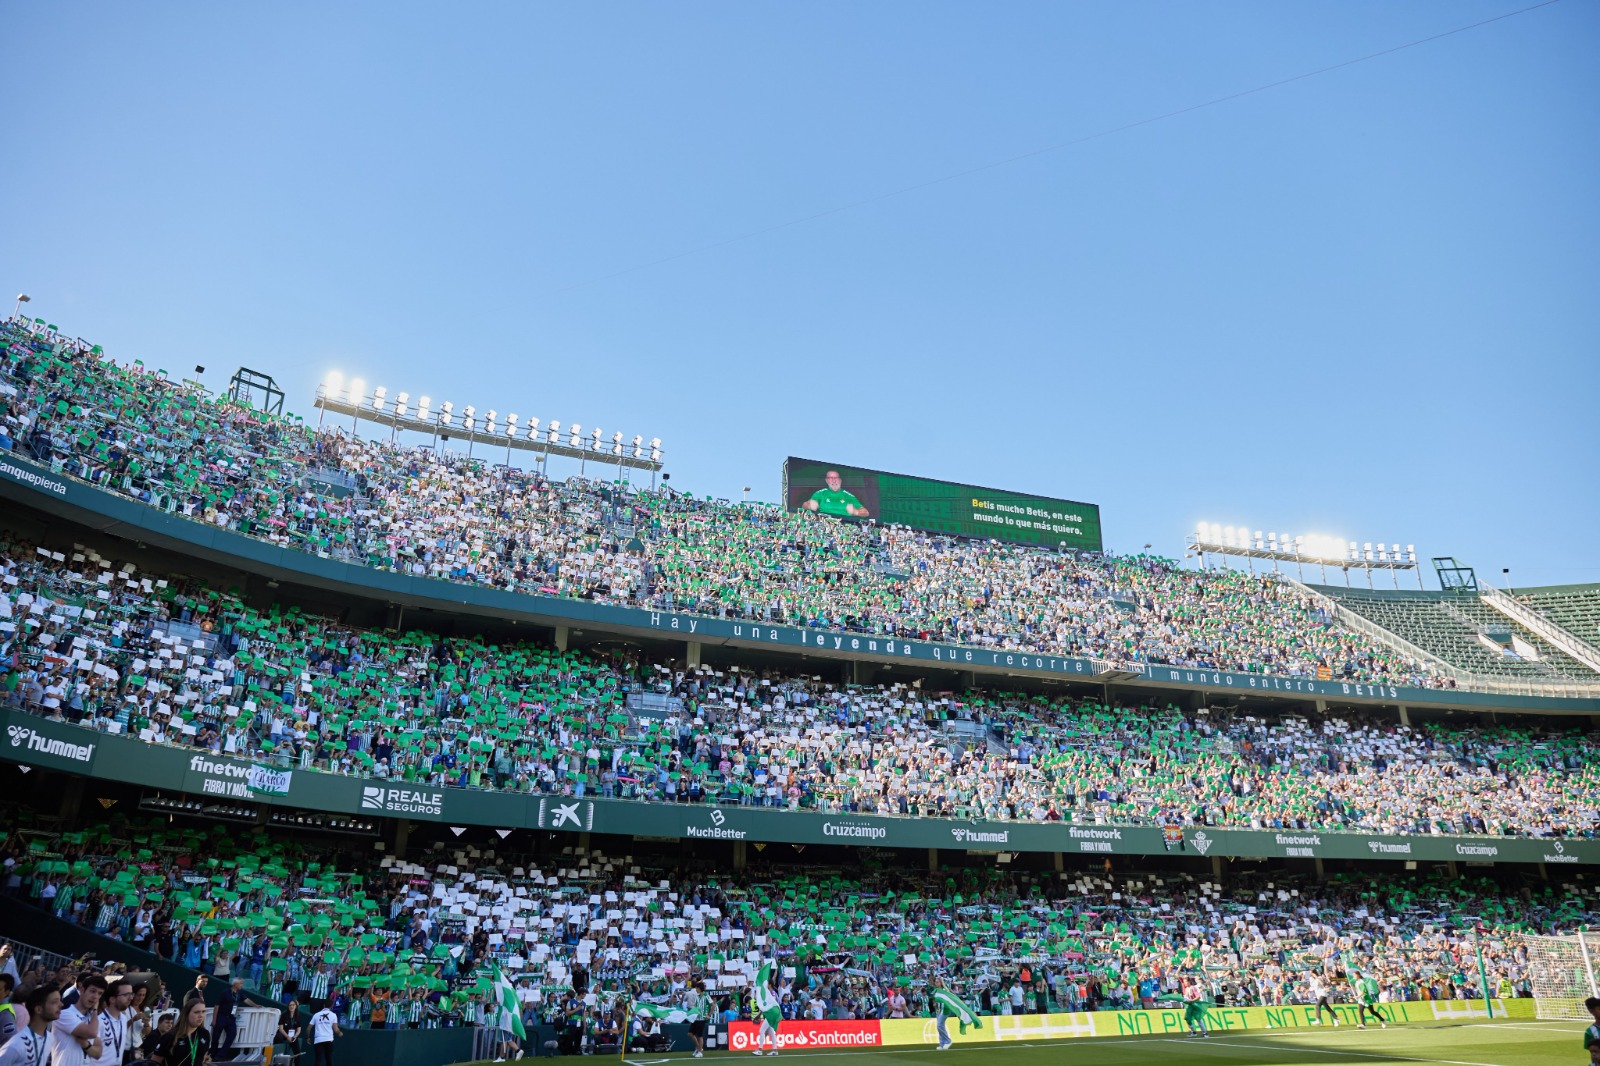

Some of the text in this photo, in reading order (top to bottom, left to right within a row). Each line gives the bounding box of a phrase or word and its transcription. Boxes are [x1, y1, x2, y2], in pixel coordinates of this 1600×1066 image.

[972, 499, 1082, 523] Betis mucho Betis, en este
[974, 513, 1083, 535] mundo lo que más quiero.
[651, 612, 697, 633] Hay
[734, 625, 778, 640] una
[802, 630, 911, 655] leyenda
[933, 647, 973, 661] que
[993, 654, 1083, 672] recorre
[1170, 670, 1233, 685] mundo
[1250, 677, 1325, 694] entero,
[1343, 683, 1398, 698] BETIS
[27, 730, 93, 761] hummel
[190, 755, 252, 780] finetwo
[203, 778, 225, 795] FIBRA
[226, 782, 233, 795] Y
[388, 789, 443, 805] REALE
[386, 802, 441, 815] SEGUROS
[687, 826, 746, 839] MuchBetter
[823, 821, 886, 839] Cruzcampo
[966, 829, 1008, 842] hummel
[1069, 826, 1122, 839] finetwork
[1275, 833, 1321, 845] finetwork
[1379, 842, 1411, 853] hummel
[1456, 843, 1498, 857] Cruzcampo
[809, 1030, 877, 1045] Santander
